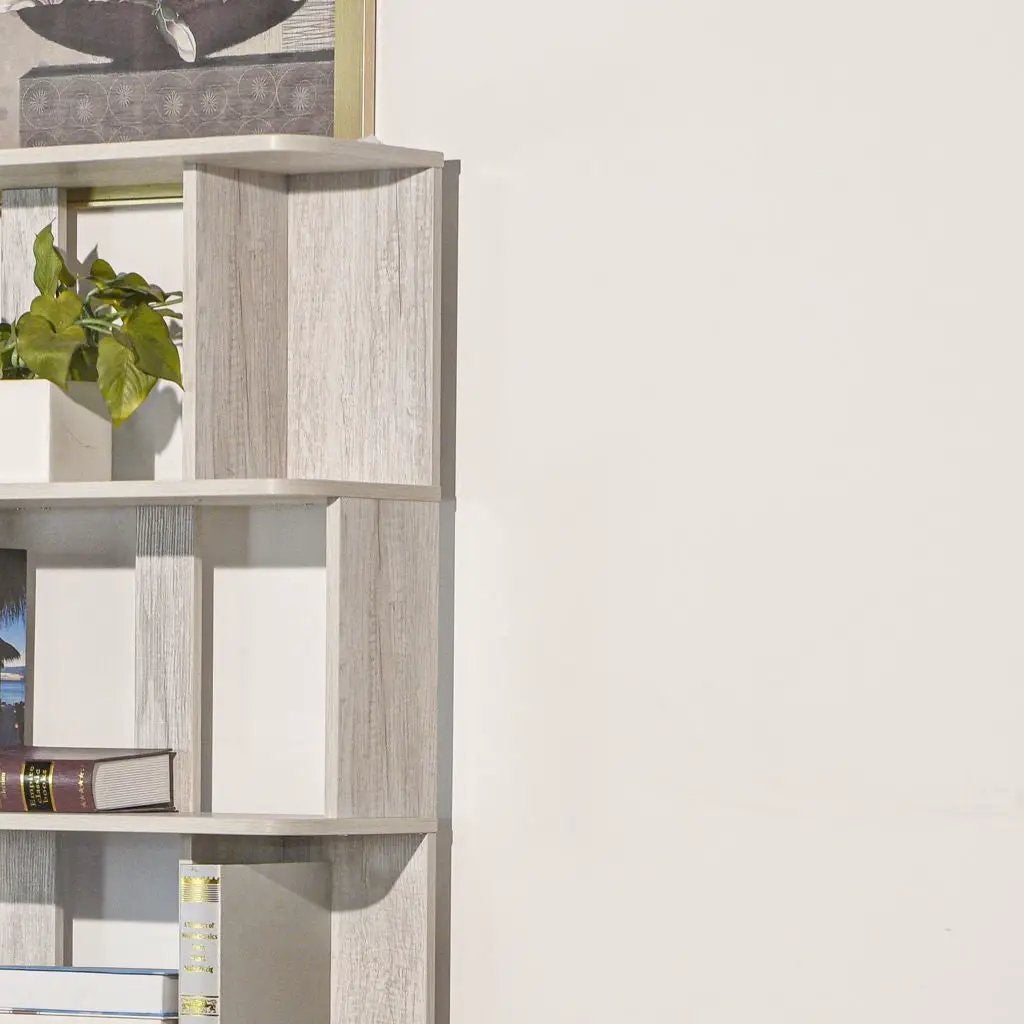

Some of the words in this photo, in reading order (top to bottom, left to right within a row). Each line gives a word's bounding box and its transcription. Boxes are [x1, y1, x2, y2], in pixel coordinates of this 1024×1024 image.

[25, 766, 36, 806] Empire
[34, 769, 42, 804] classic
[40, 770, 48, 804] books
